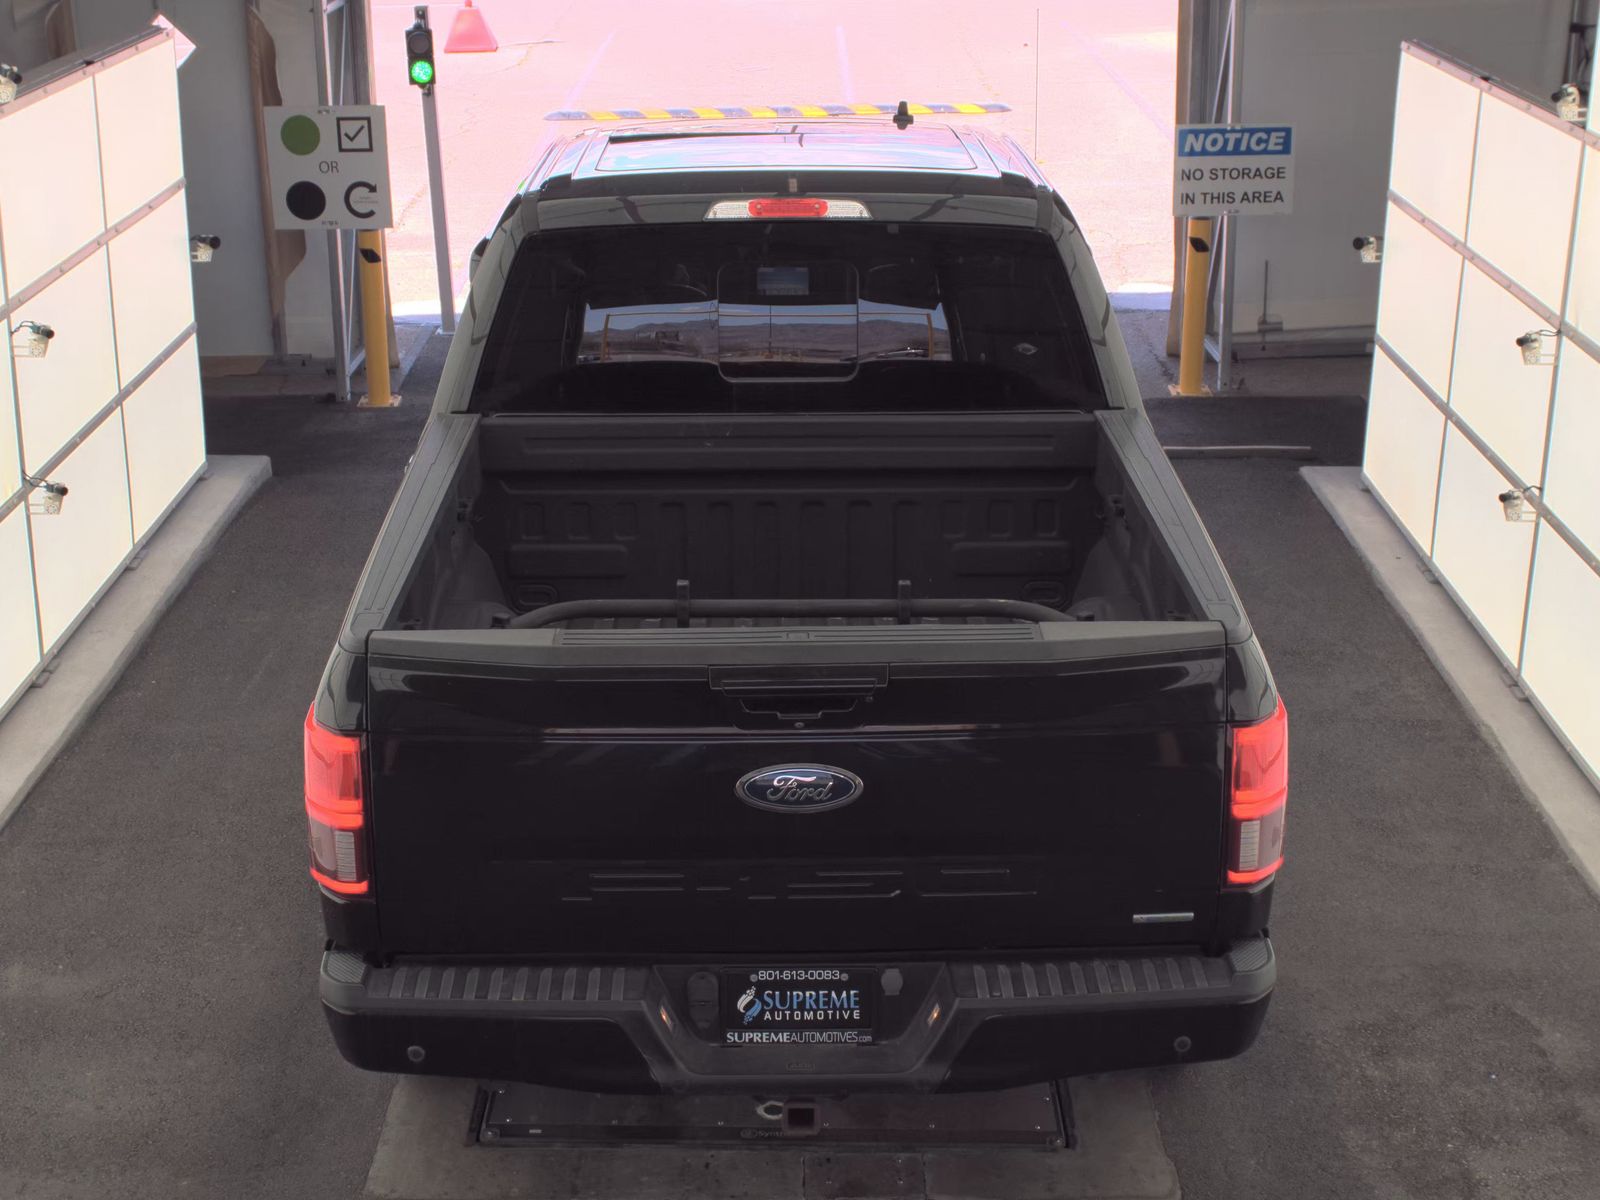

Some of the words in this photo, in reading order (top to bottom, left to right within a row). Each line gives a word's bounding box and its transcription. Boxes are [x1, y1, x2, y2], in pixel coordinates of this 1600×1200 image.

[1184, 131, 1286, 153] NOTICE
[318, 160, 340, 174] OR
[1181, 168, 1204, 181] NO
[1209, 166, 1287, 181] STORAGE
[1180, 192, 1195, 205] IN
[1200, 191, 1236, 205] THIS
[1240, 190, 1285, 204] AREA
[766, 774, 834, 801] Ford
[758, 970, 840, 981] 801-613-0083
[763, 990, 860, 1010] SUPREME
[764, 1010, 861, 1021] AUTOMOTIVE
[726, 1031, 873, 1043] SUPREMEAUTOMOTIVES.com
